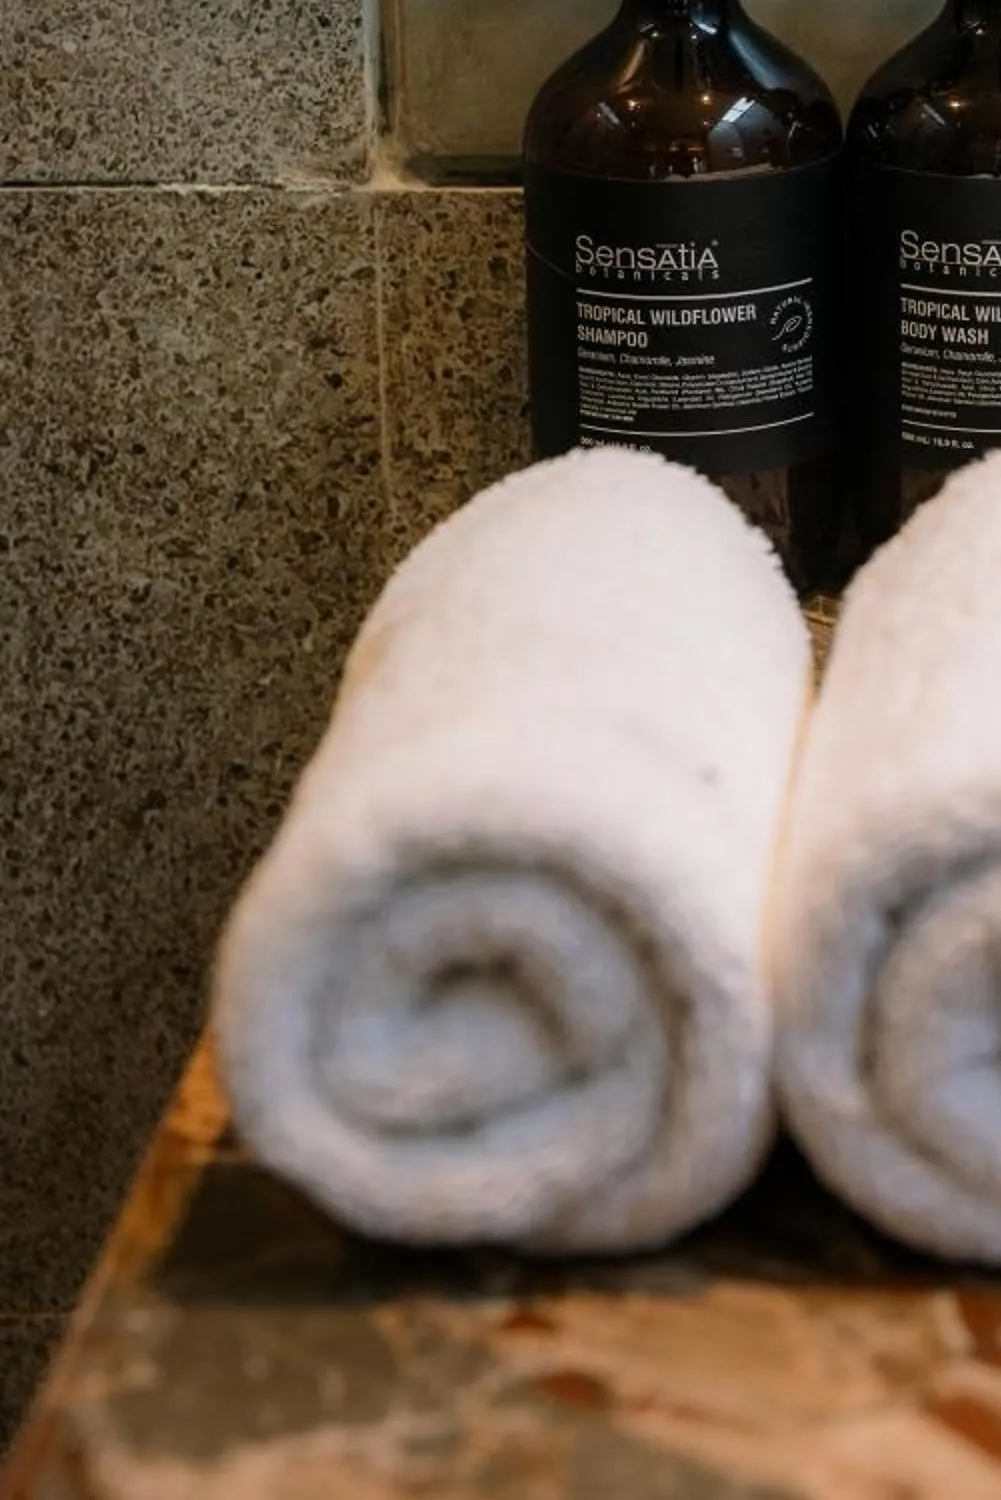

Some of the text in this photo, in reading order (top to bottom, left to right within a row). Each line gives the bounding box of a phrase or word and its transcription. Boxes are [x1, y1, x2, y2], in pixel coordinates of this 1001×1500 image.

[577, 302, 757, 326] TROPICAL WILDFLOWER
[901, 298, 970, 322] TROPICAL
[577, 324, 648, 348] SHAMPOO
[901, 320, 989, 345] BODY WASH
